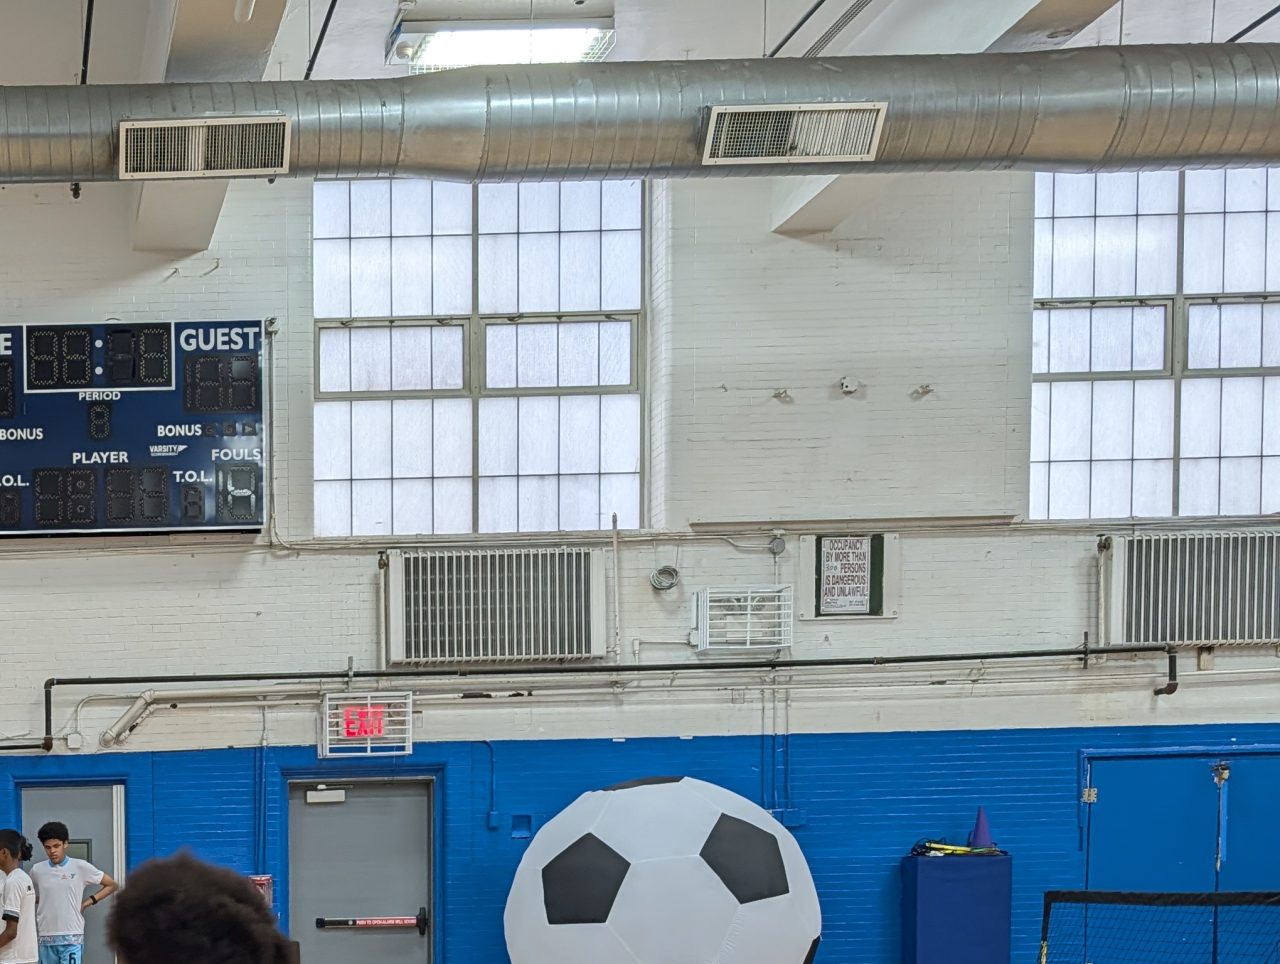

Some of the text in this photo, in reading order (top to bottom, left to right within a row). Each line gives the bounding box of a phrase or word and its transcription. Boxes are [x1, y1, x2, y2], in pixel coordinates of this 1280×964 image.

[179, 327, 260, 352] GUEST
[78, 391, 121, 401] PERIOD
[0, 428, 44, 440] BONUS
[157, 424, 202, 437] BONUS
[149, 445, 178, 453] VARSITY
[211, 448, 261, 461] FOULS
[72, 451, 129, 464] PLAYER
[172, 470, 213, 483] T.O.L.
[829, 540, 863, 551] OCCUPANCY
[825, 551, 867, 562] BY MORE THAN
[840, 562, 866, 573] PERSONS
[825, 574, 866, 585] IS DANGEROUS
[824, 586, 867, 597] AND UNLAWFUL
[344, 705, 384, 737] EXIT
